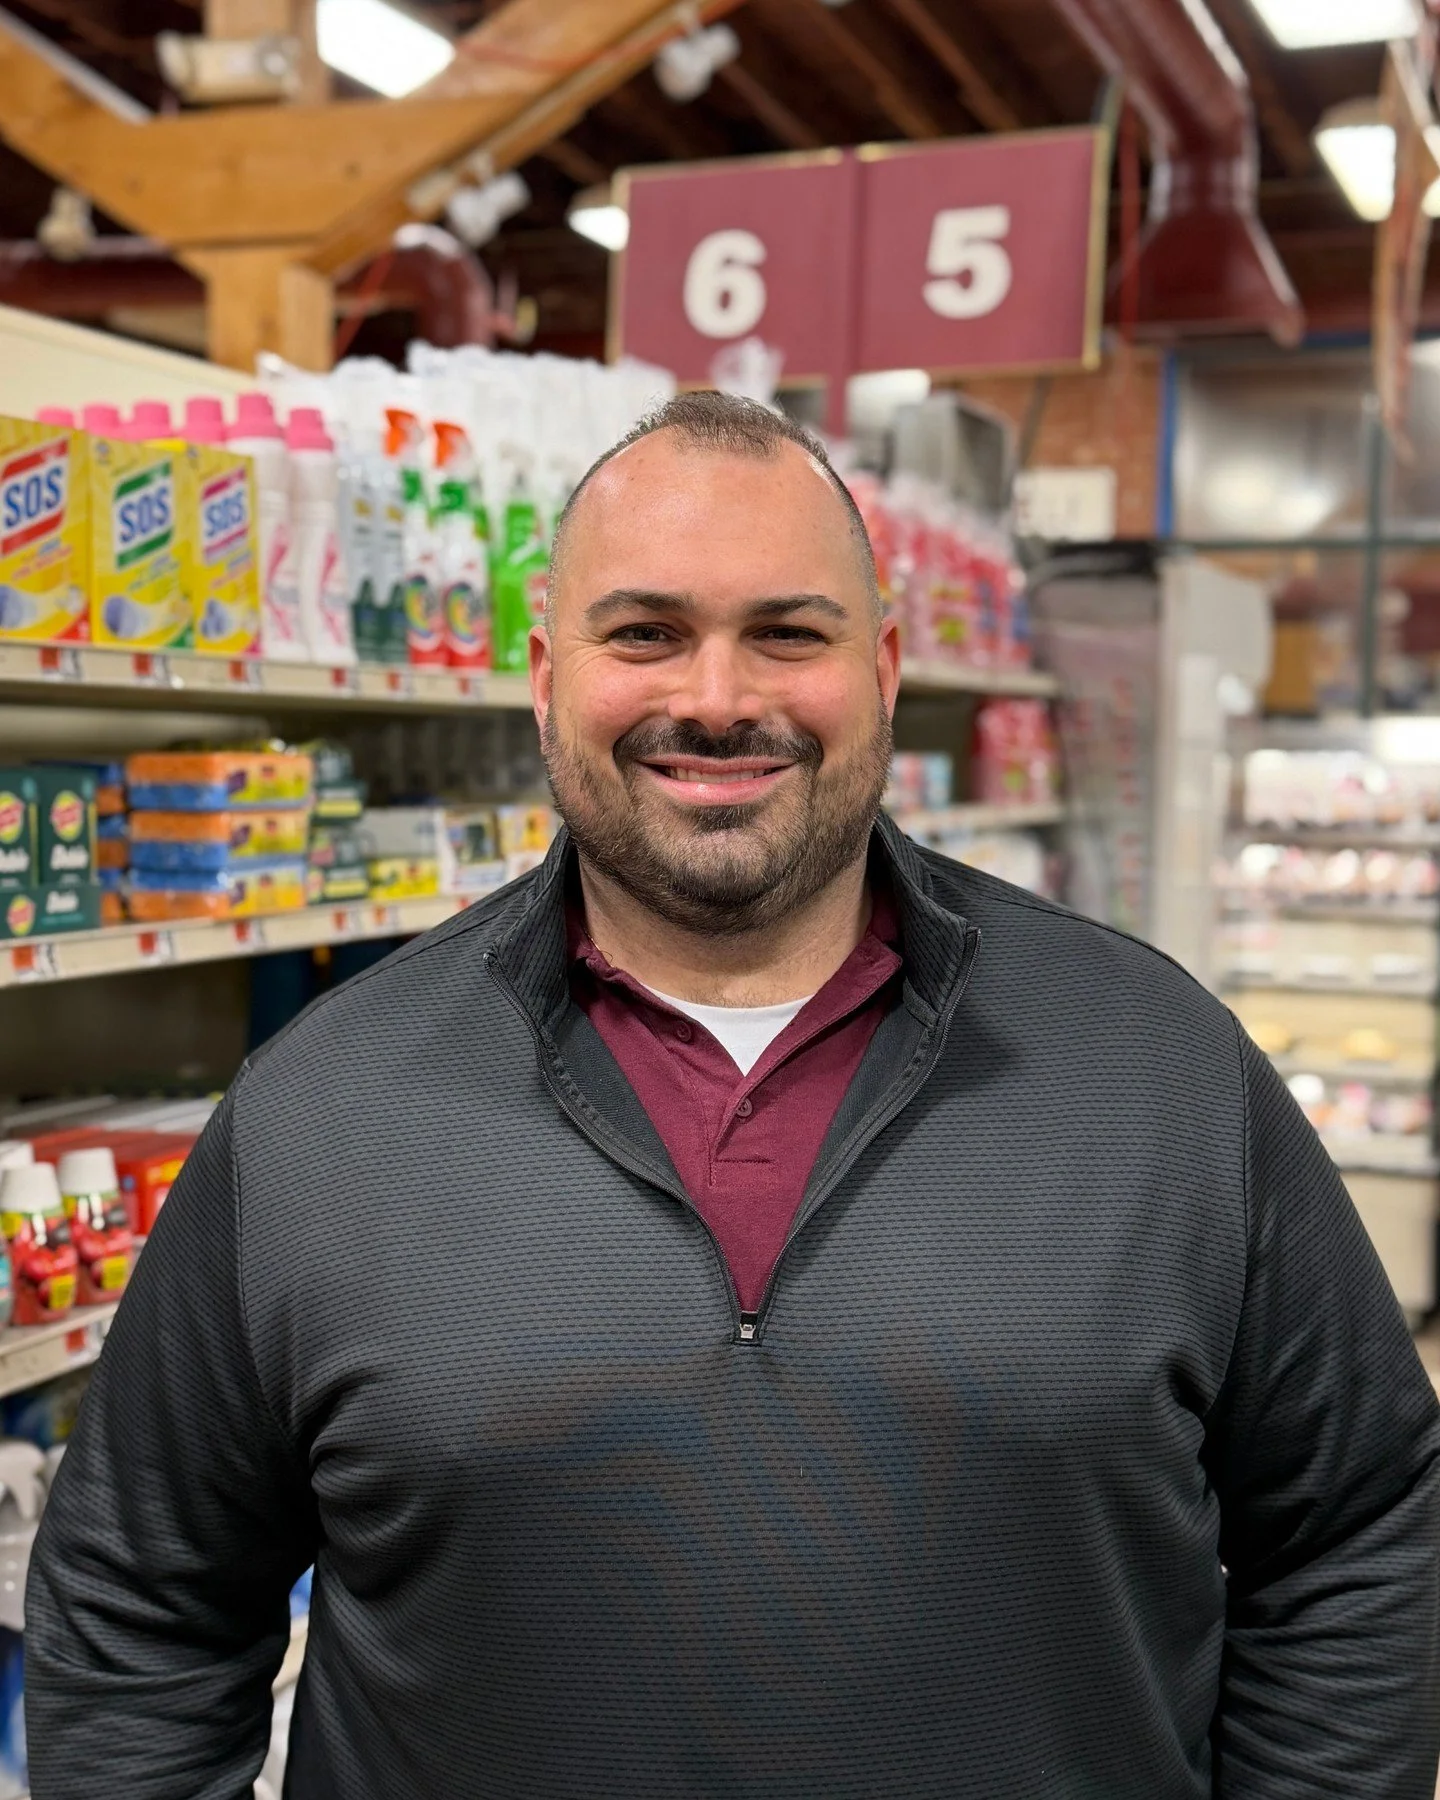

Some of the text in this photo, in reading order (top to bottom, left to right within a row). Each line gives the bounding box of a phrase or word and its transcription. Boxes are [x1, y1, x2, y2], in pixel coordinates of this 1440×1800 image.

[684, 229, 766, 338] 6
[923, 205, 1011, 319] 5
[4, 466, 62, 528] SOS
[118, 487, 169, 542] SOS
